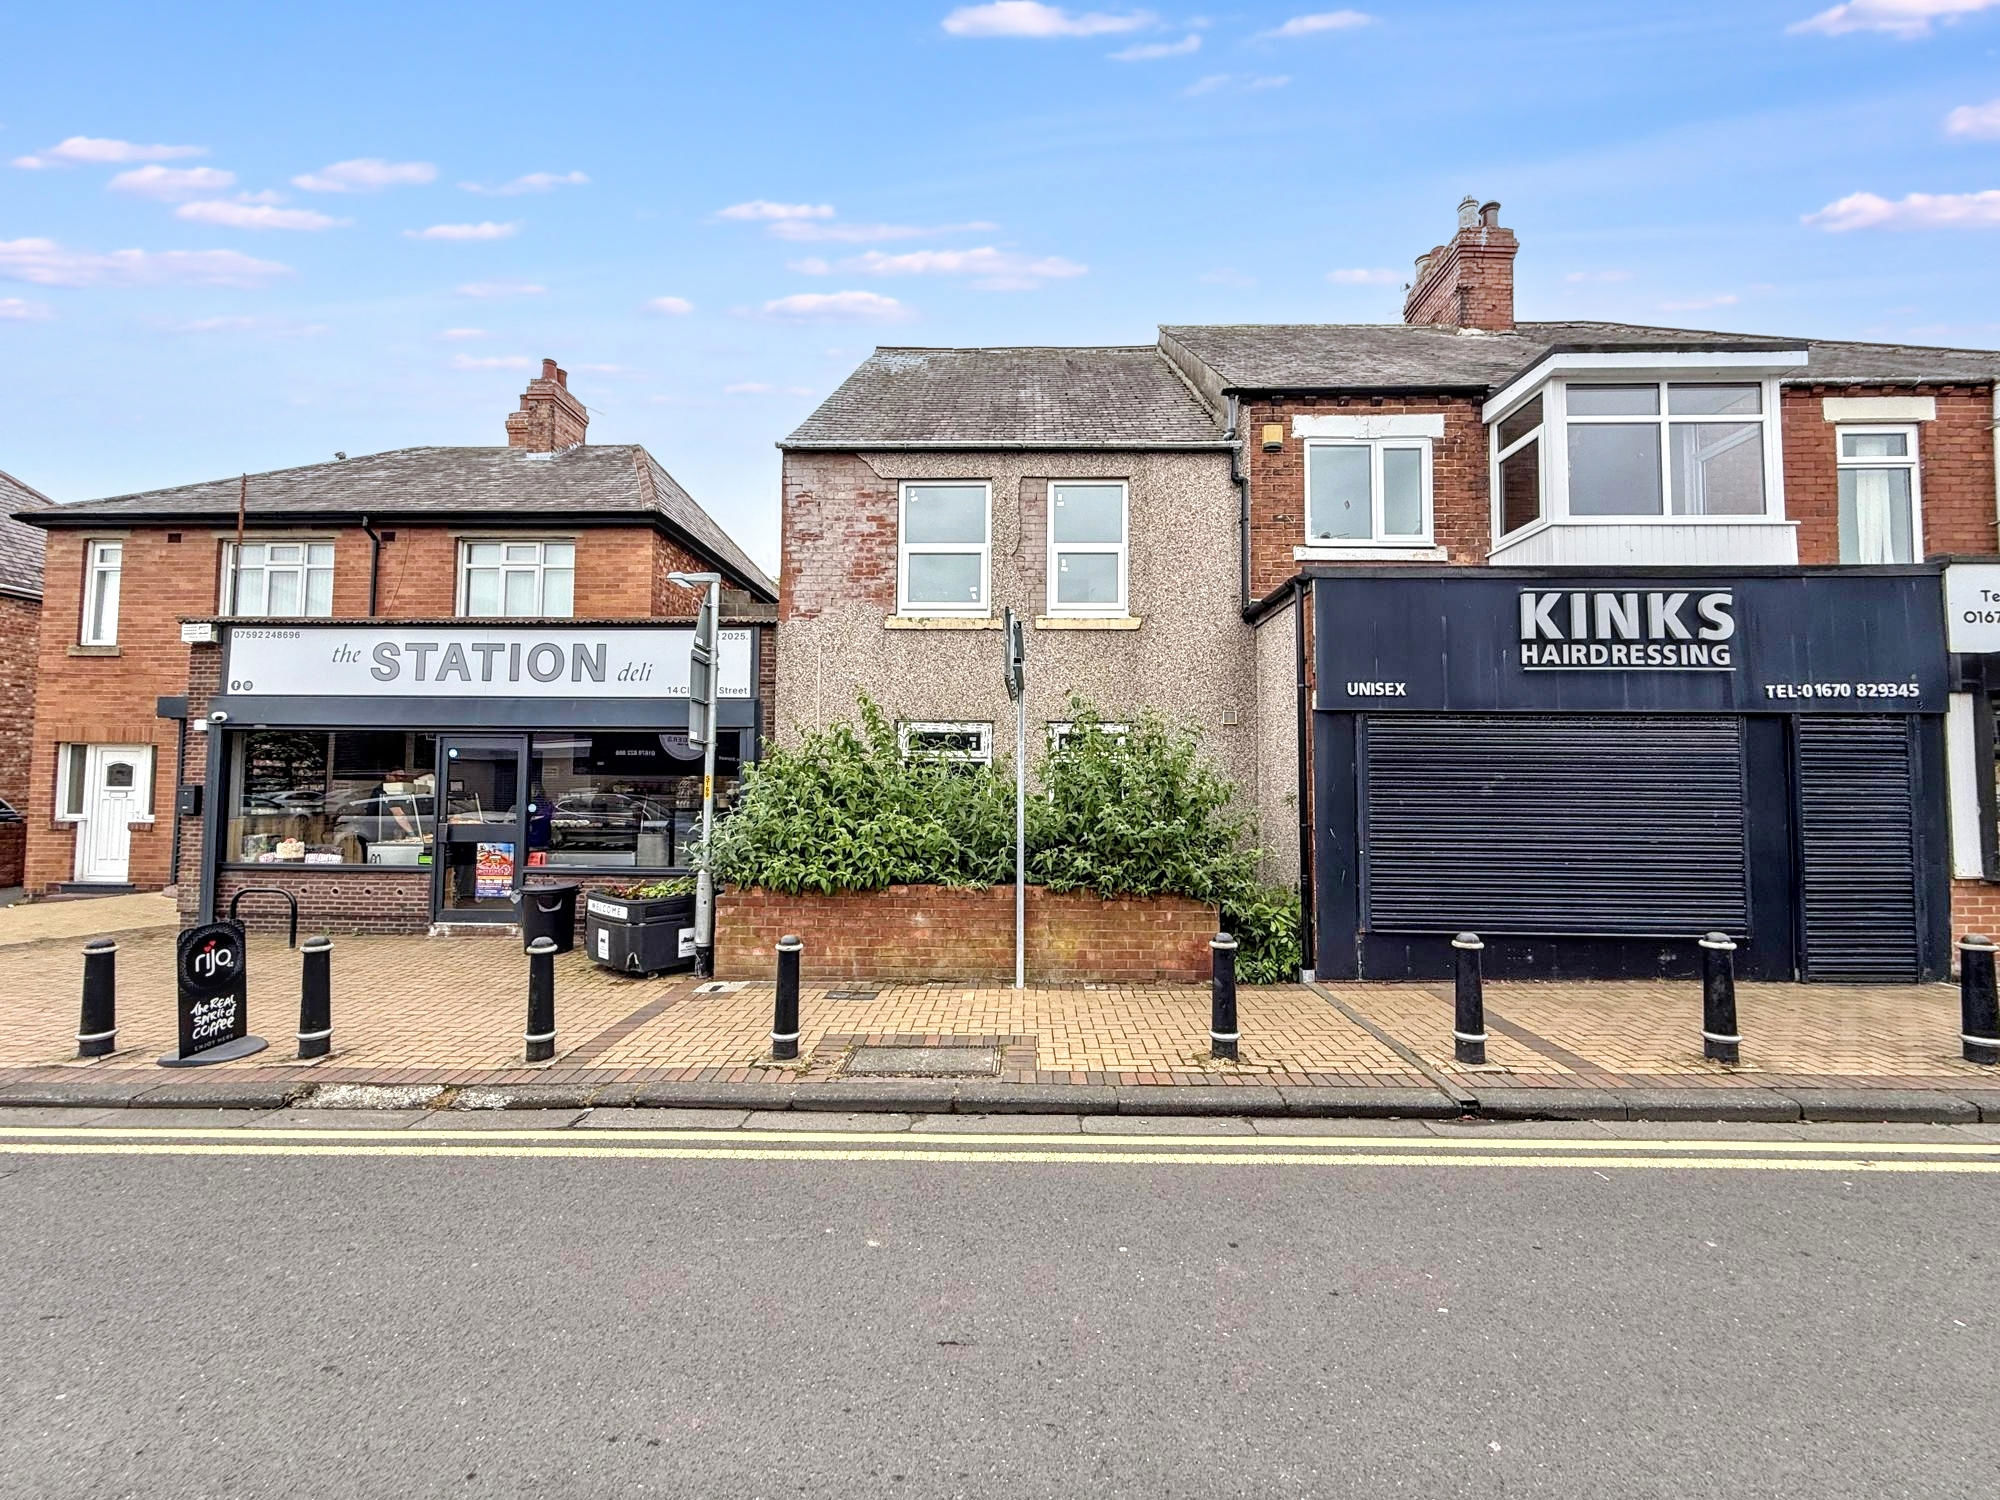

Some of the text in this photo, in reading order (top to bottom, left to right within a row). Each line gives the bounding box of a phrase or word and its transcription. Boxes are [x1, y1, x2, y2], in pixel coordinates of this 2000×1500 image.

[1520, 592, 1735, 641] KINKS
[332, 641, 653, 682] the STATION deli
[1521, 644, 1731, 665] HAIRDRESSING
[667, 686, 678, 694] 14
[719, 686, 748, 695] Street
[1347, 682, 1407, 696] UNISEX
[1856, 683, 1920, 698] 829345
[591, 902, 621, 916] WELCOME
[195, 940, 232, 977] rijo
[190, 1001, 209, 1016] The
[225, 1004, 237, 1016] of
[194, 1040, 215, 1052] ENJOY
